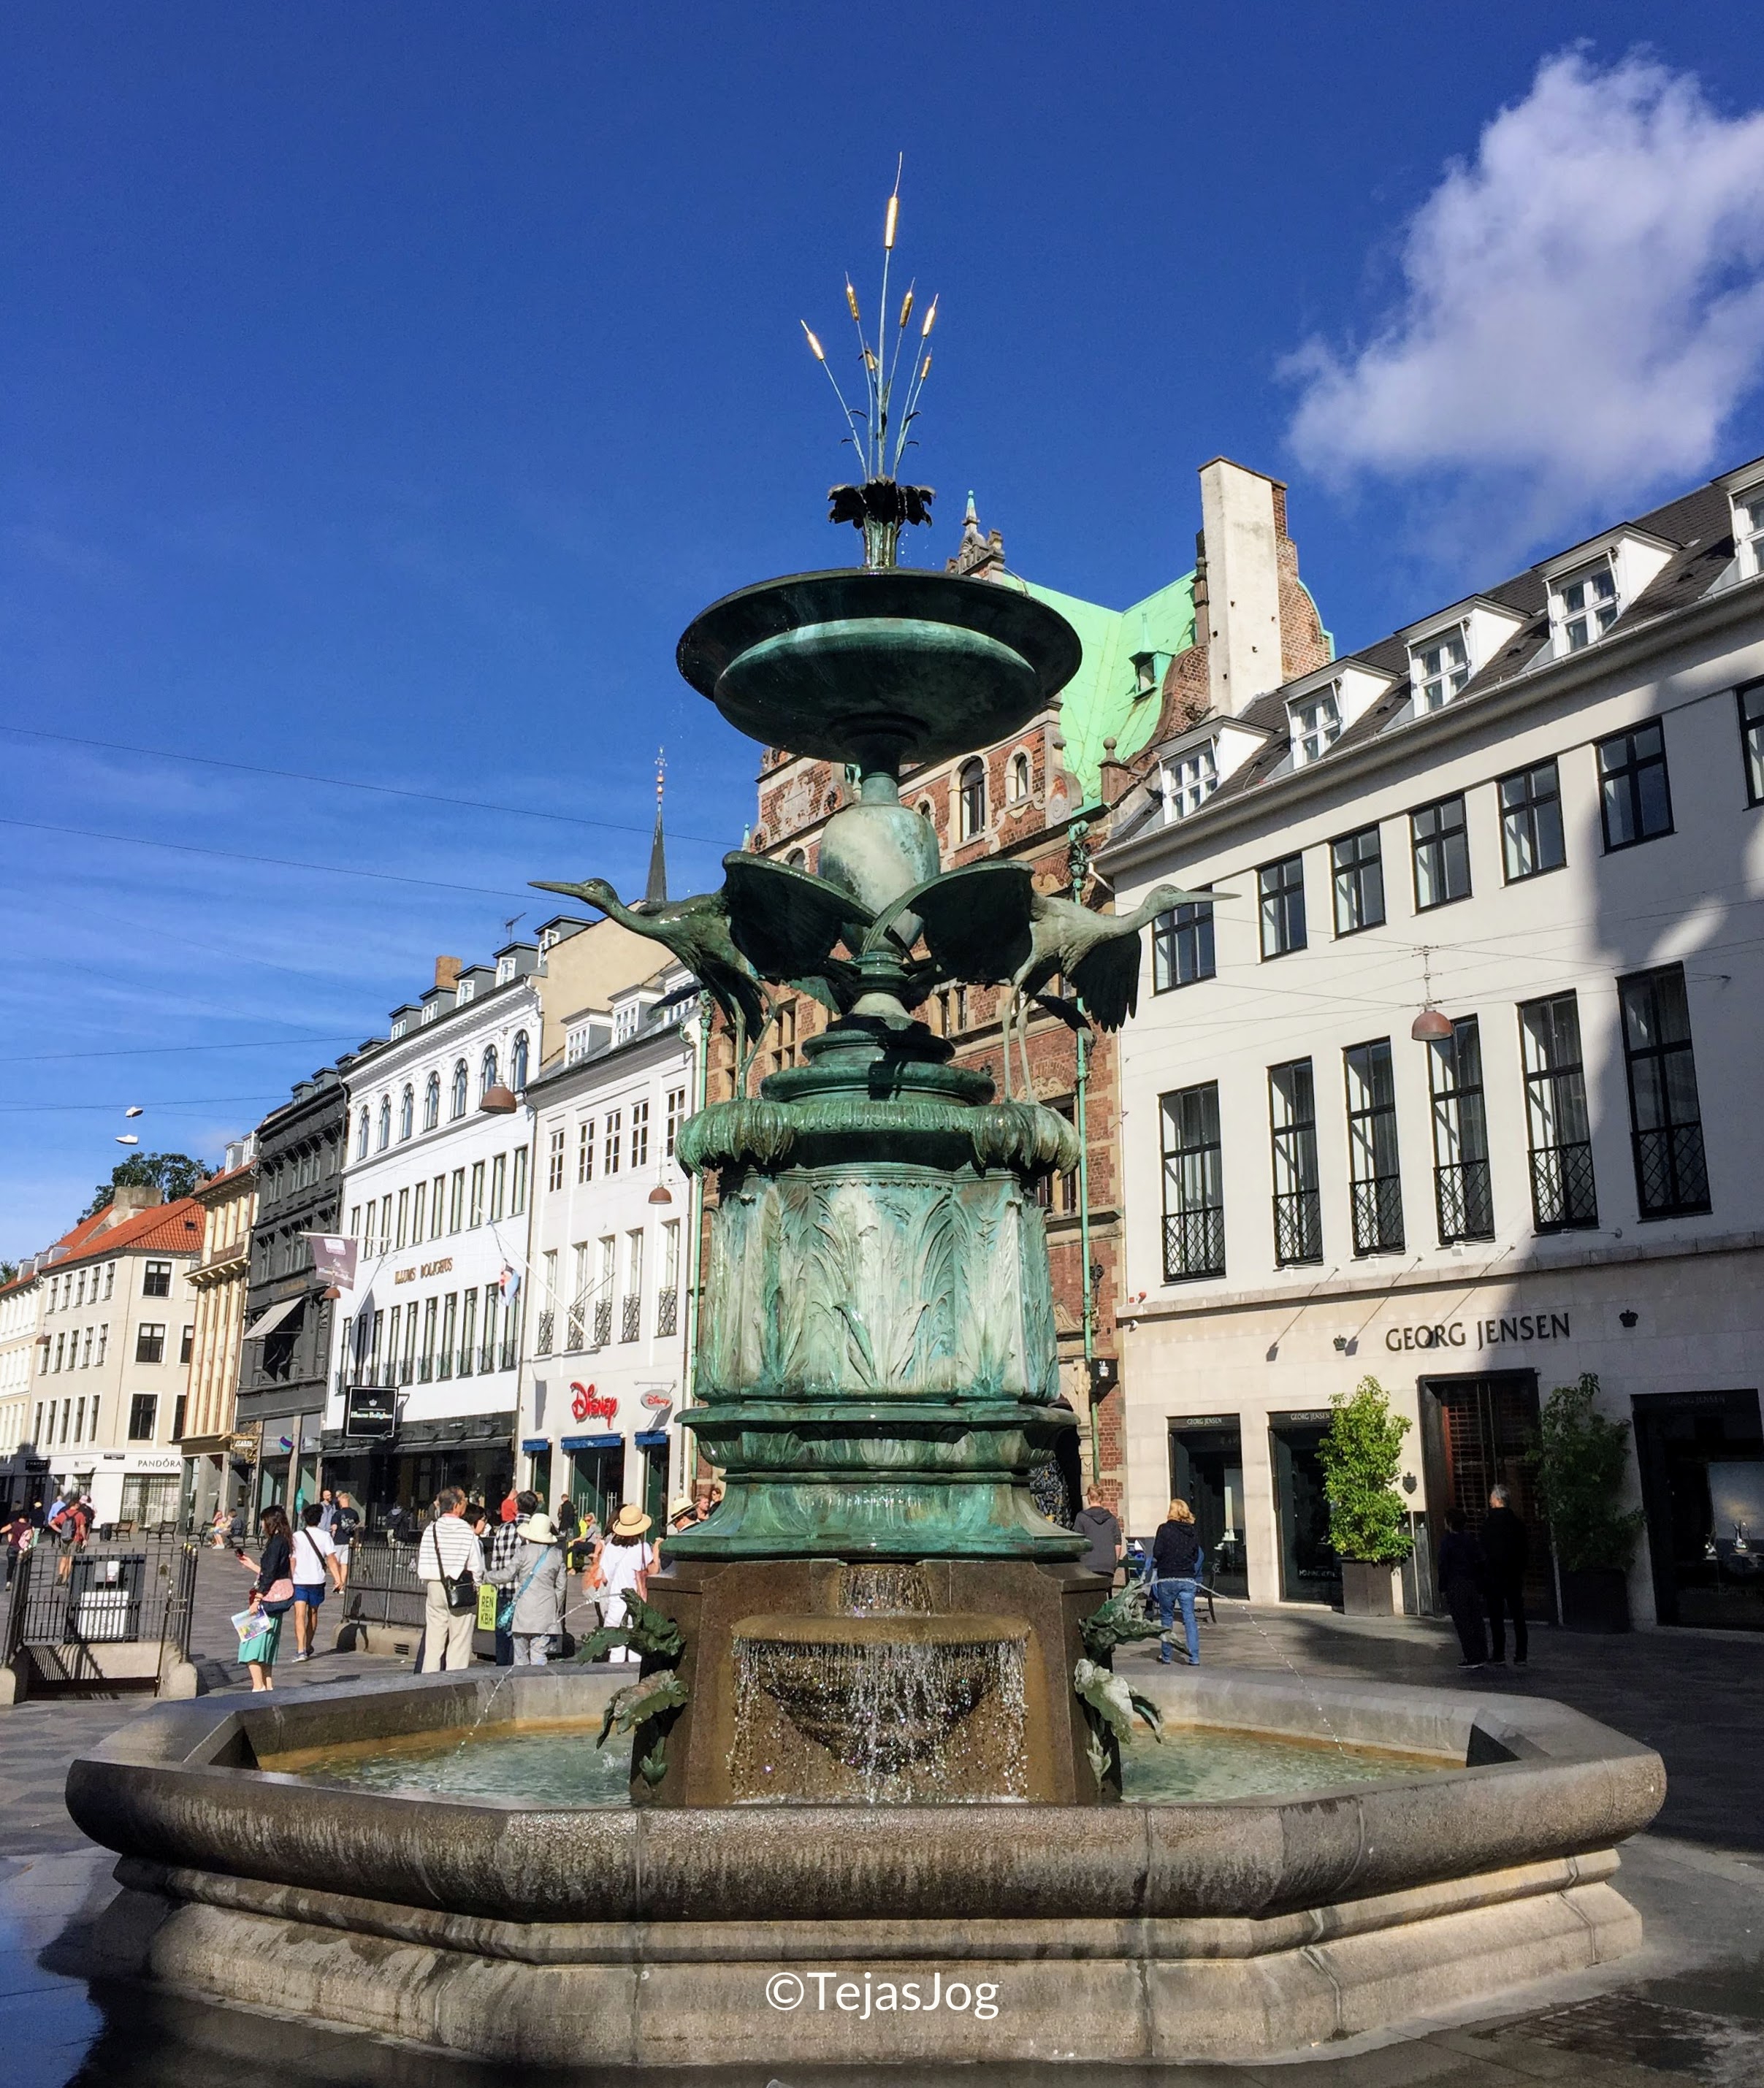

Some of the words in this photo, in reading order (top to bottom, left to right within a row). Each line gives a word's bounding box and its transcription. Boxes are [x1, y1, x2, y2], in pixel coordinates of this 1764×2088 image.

[1386, 1322, 1466, 1352] GEORG
[1477, 1312, 1570, 1351] JENSEN
[1204, 1416, 1222, 1426] JENSEN
[1290, 1412, 1310, 1421] GEORG
[1310, 1411, 1331, 1421] JENSEN
[481, 1596, 494, 1608] REN
[481, 1613, 493, 1626] KBH
